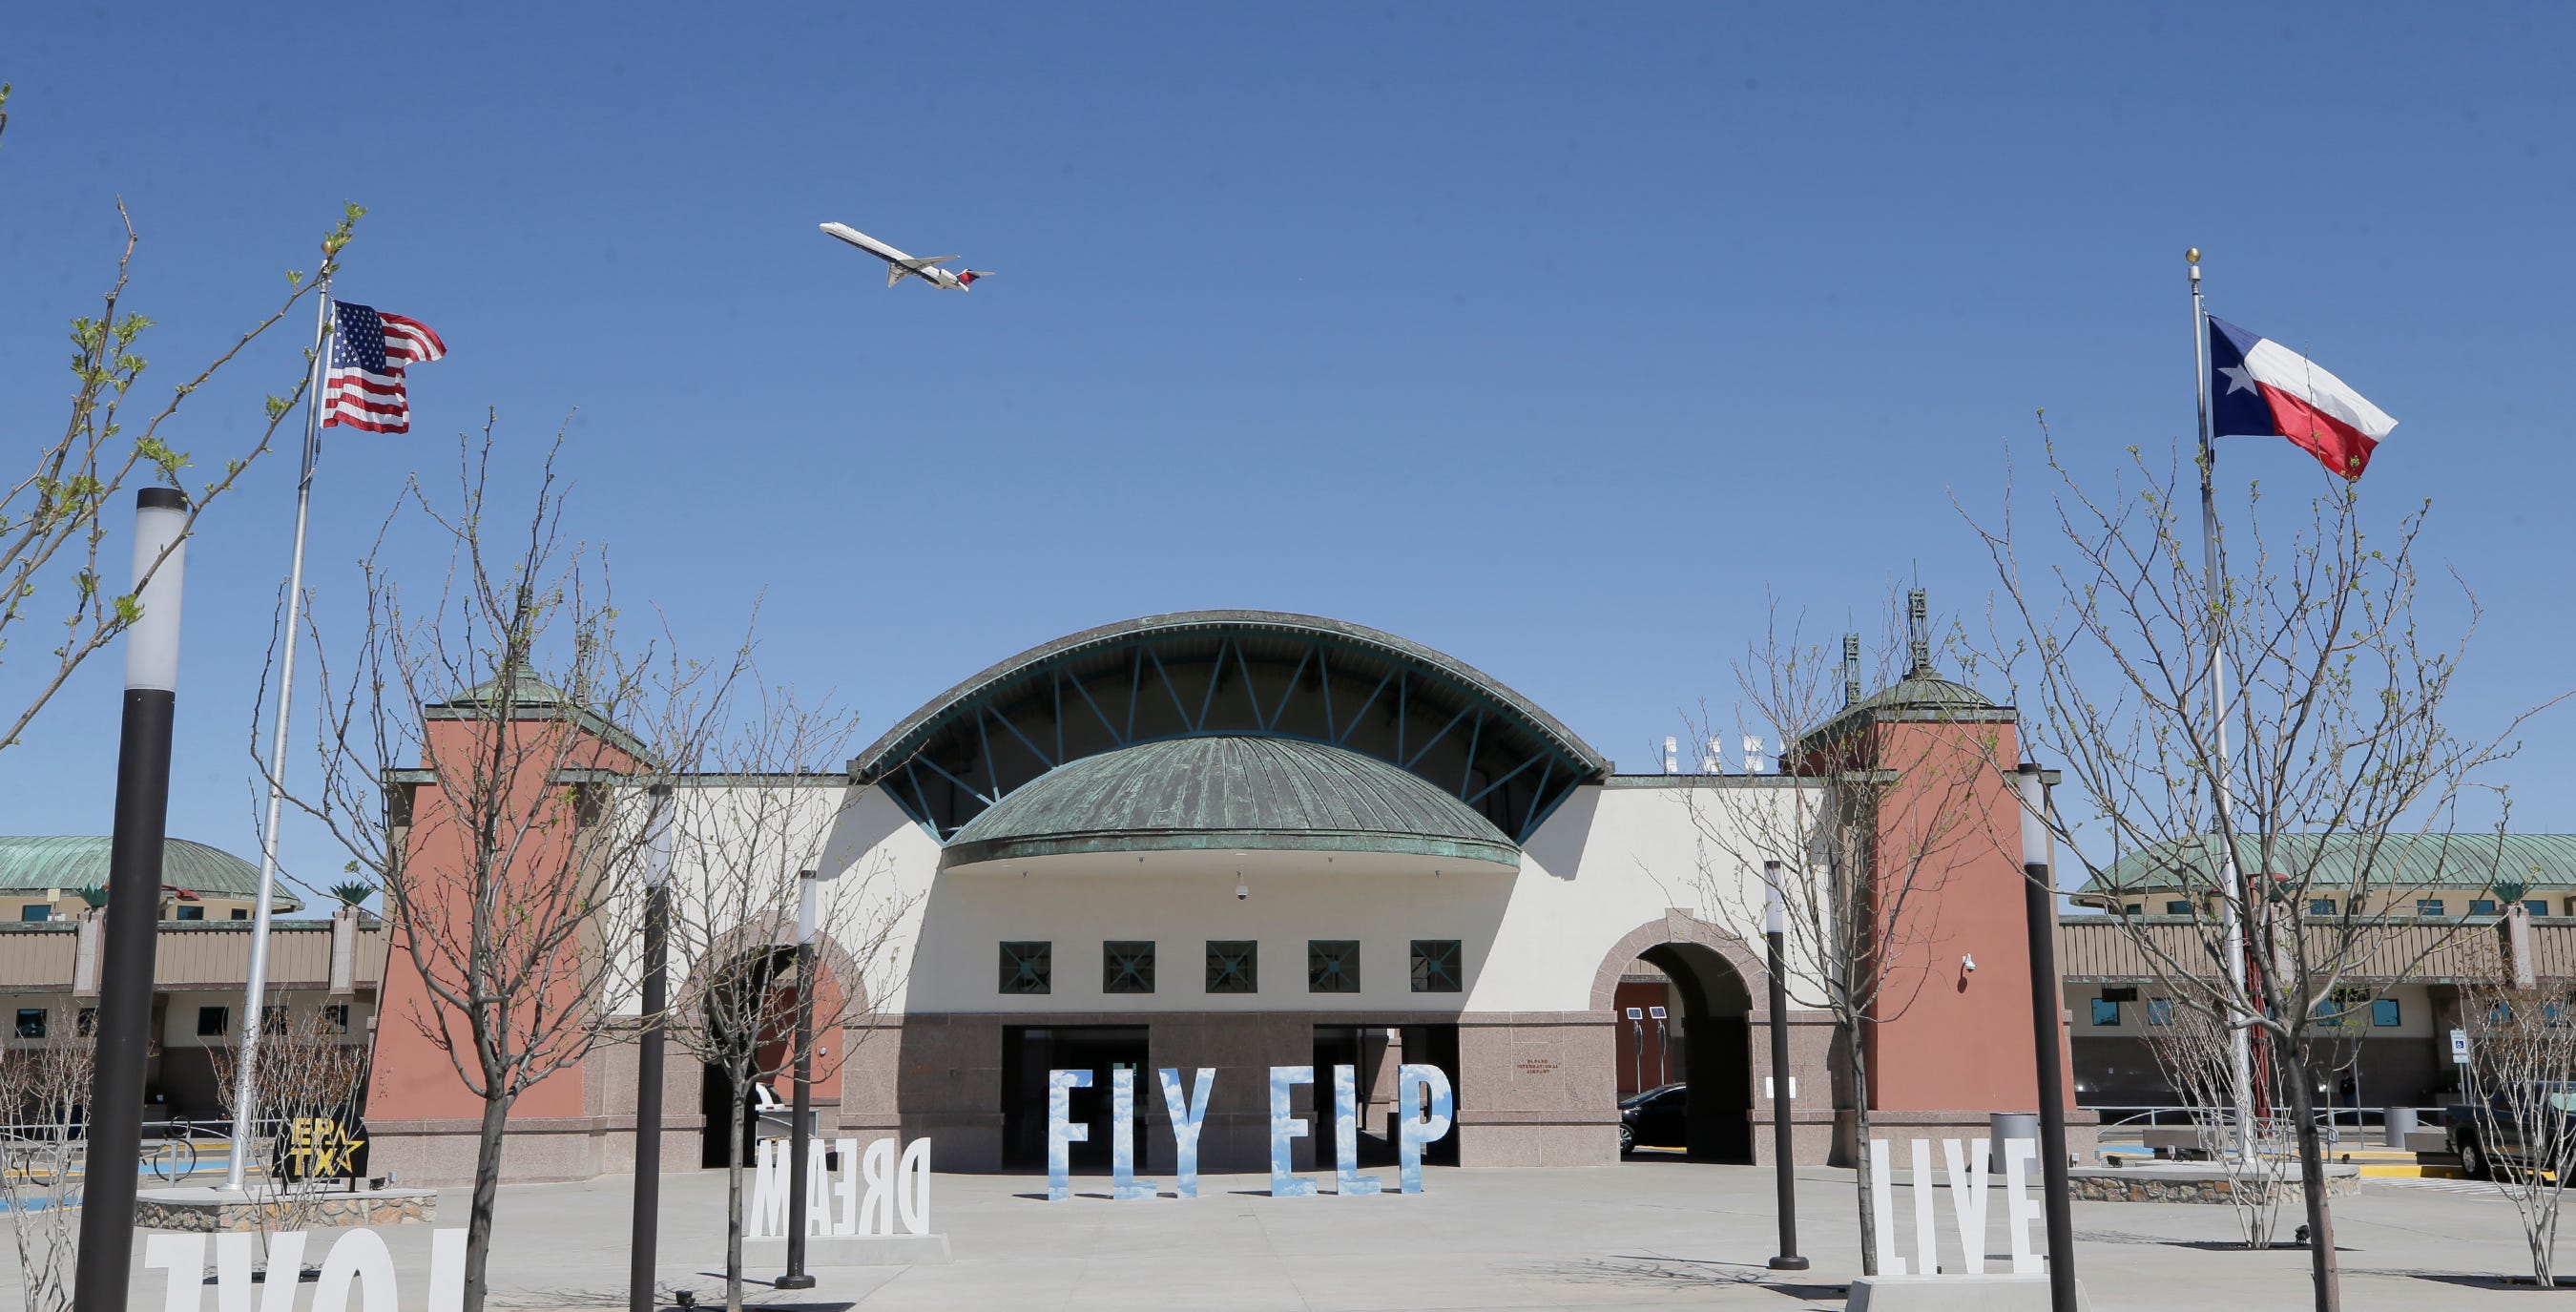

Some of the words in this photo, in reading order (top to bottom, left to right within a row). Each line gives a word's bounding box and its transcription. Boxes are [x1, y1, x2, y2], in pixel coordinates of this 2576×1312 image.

[289, 1148, 338, 1176] TX
[1048, 1068, 1216, 1201] FLY
[1269, 1064, 1453, 1197] ELP
[1870, 1137, 2045, 1275] LIVE
